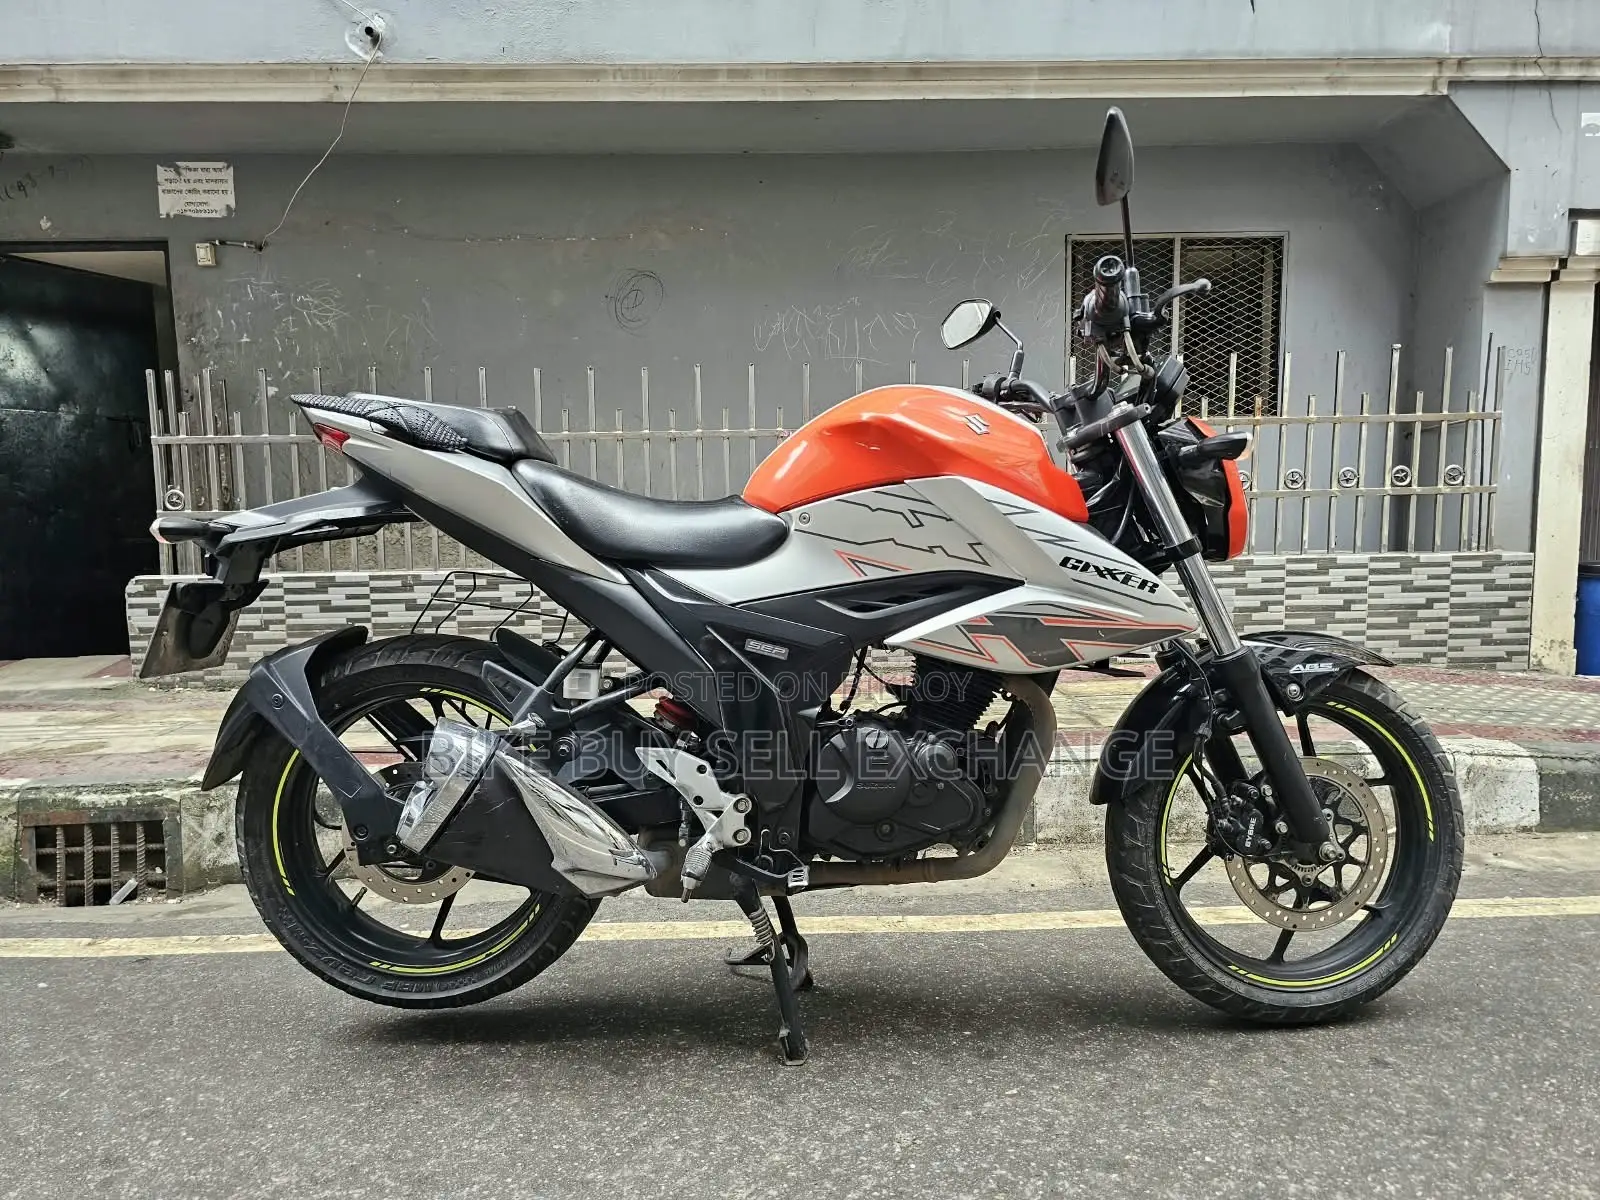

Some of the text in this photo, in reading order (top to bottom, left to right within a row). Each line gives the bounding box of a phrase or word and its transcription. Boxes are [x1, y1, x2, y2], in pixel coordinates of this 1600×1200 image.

[1059, 556, 1160, 594] GIXXER
[747, 641, 786, 654] SEP
[1289, 662, 1334, 673] ABS
